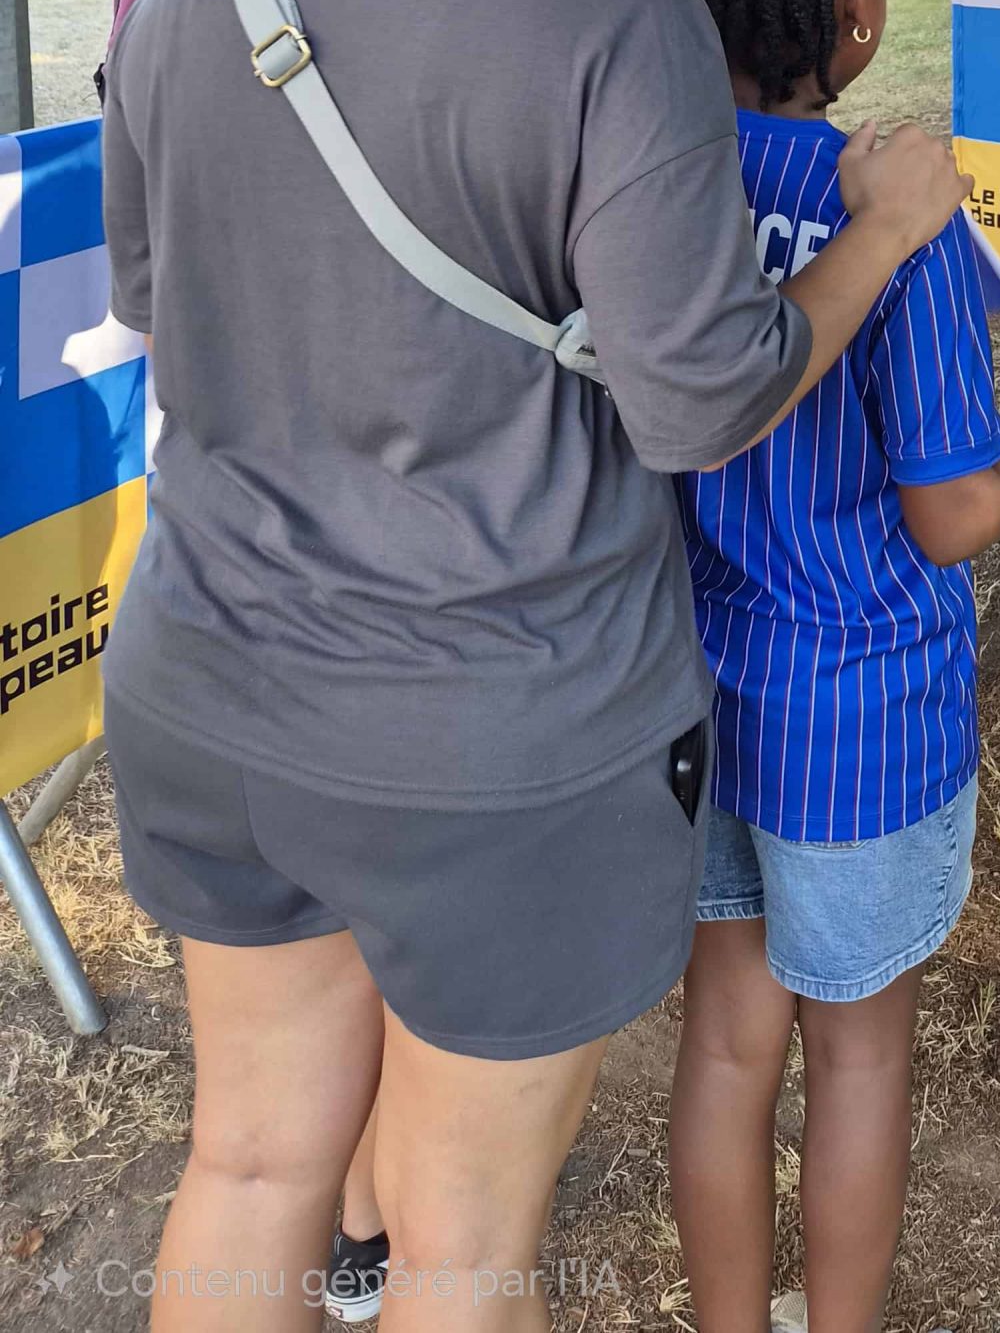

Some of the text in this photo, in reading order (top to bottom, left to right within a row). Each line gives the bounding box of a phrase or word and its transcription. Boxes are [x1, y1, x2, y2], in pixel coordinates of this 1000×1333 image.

[970, 189, 995, 206] Le
[748, 208, 830, 286] CE
[0, 583, 109, 661] toire
[0, 623, 109, 715] peau
